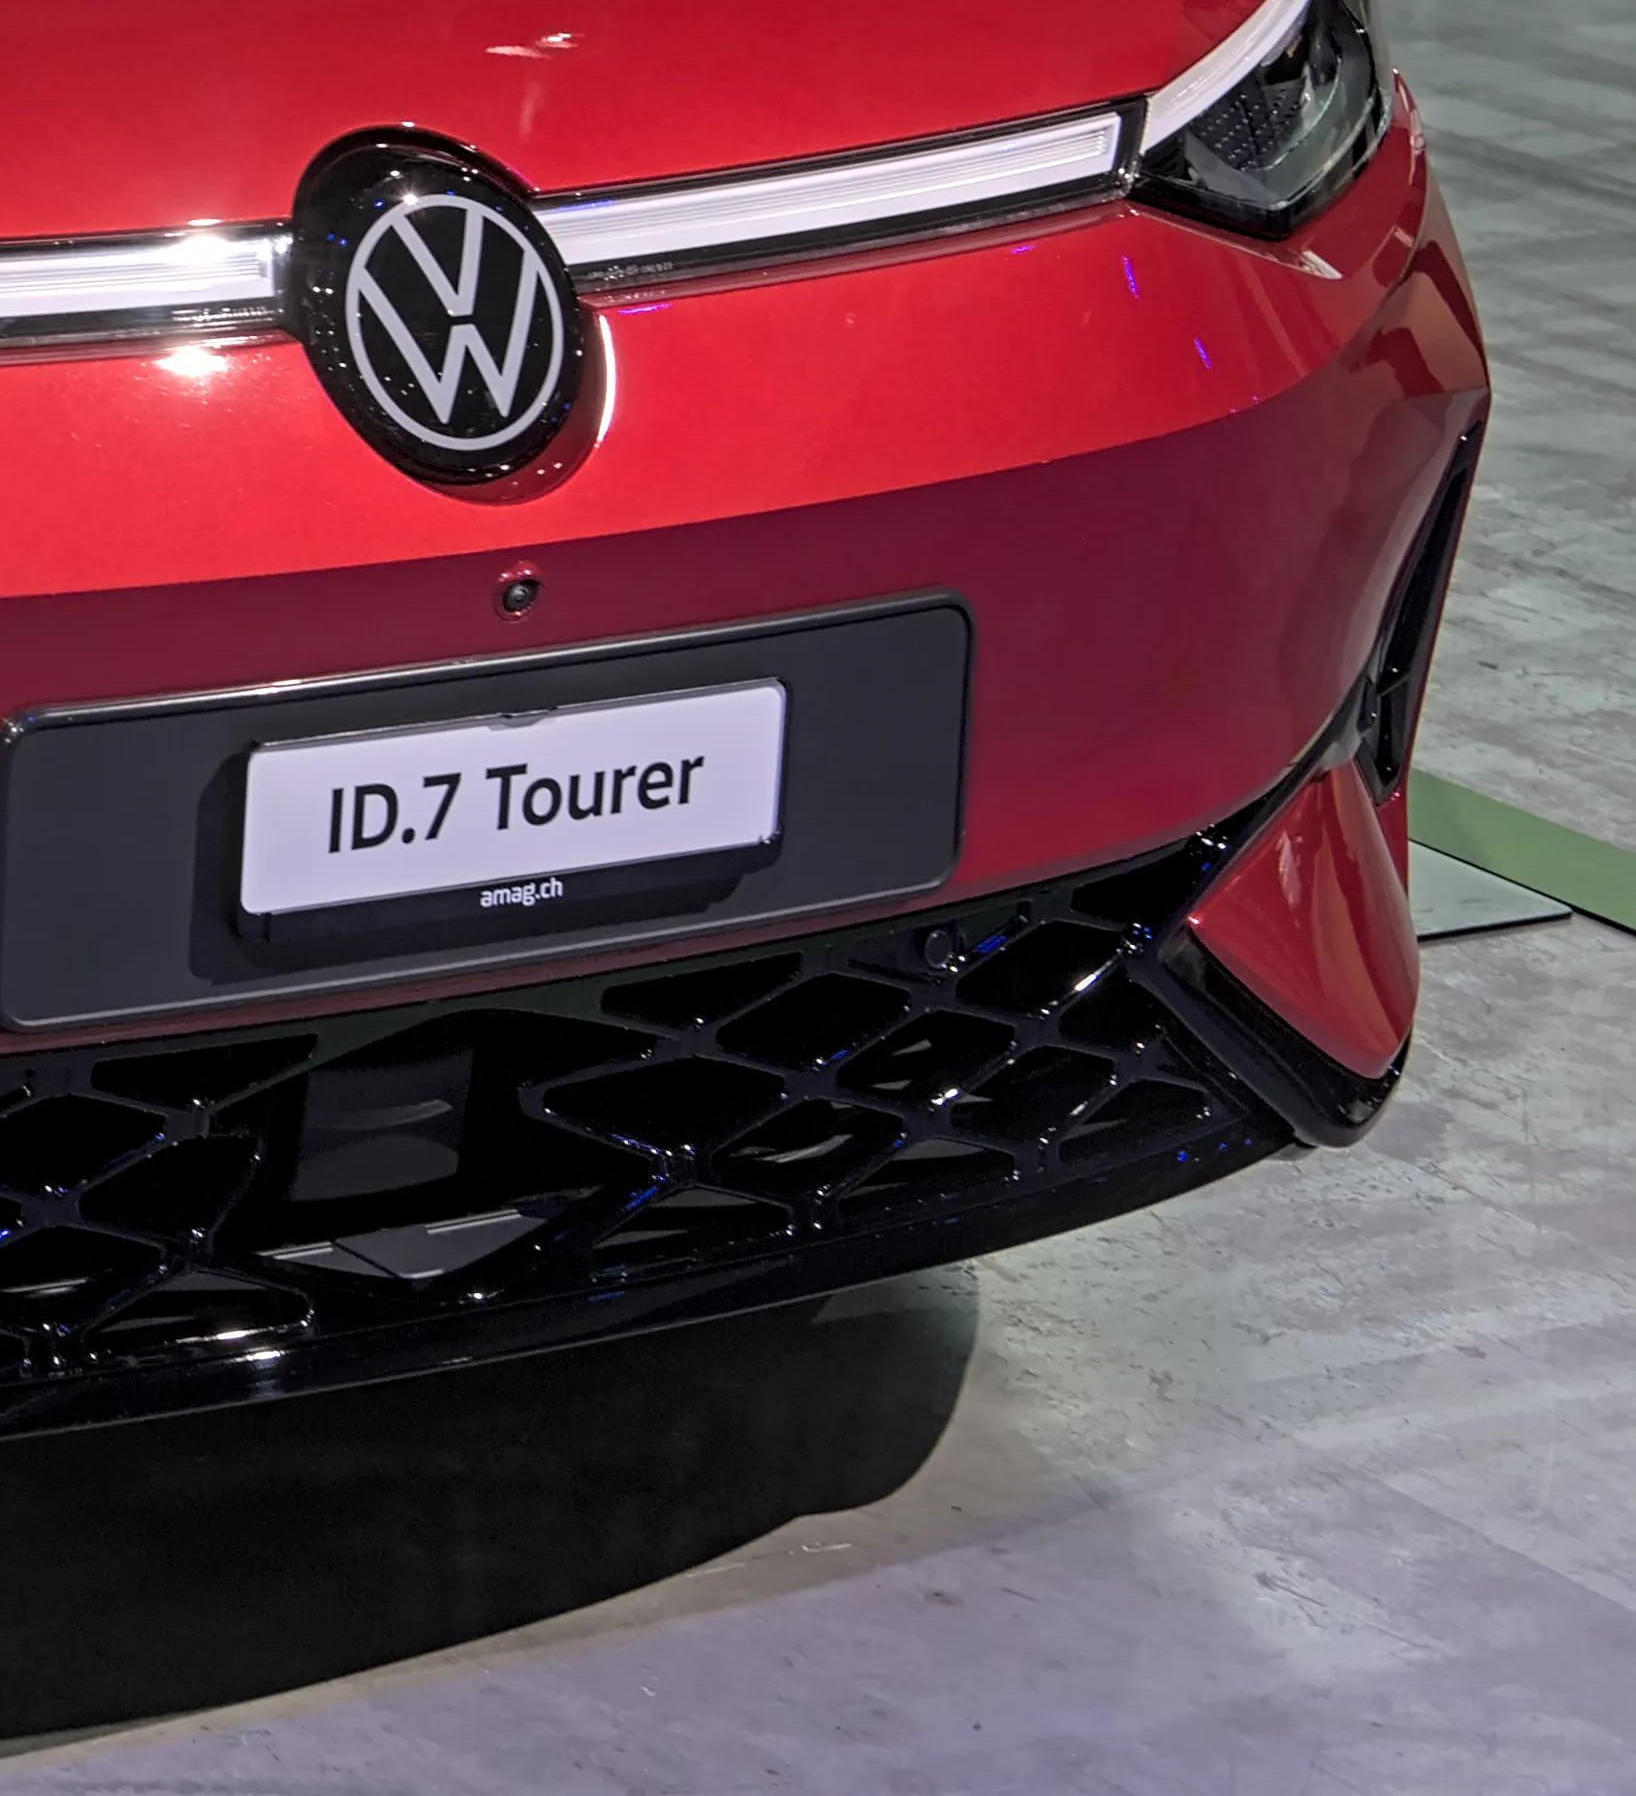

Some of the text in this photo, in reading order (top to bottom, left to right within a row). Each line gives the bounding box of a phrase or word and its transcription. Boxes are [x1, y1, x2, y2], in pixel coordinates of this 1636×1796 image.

[328, 753, 707, 855] ID.7 Tourer
[478, 876, 564, 910] amag.ch
